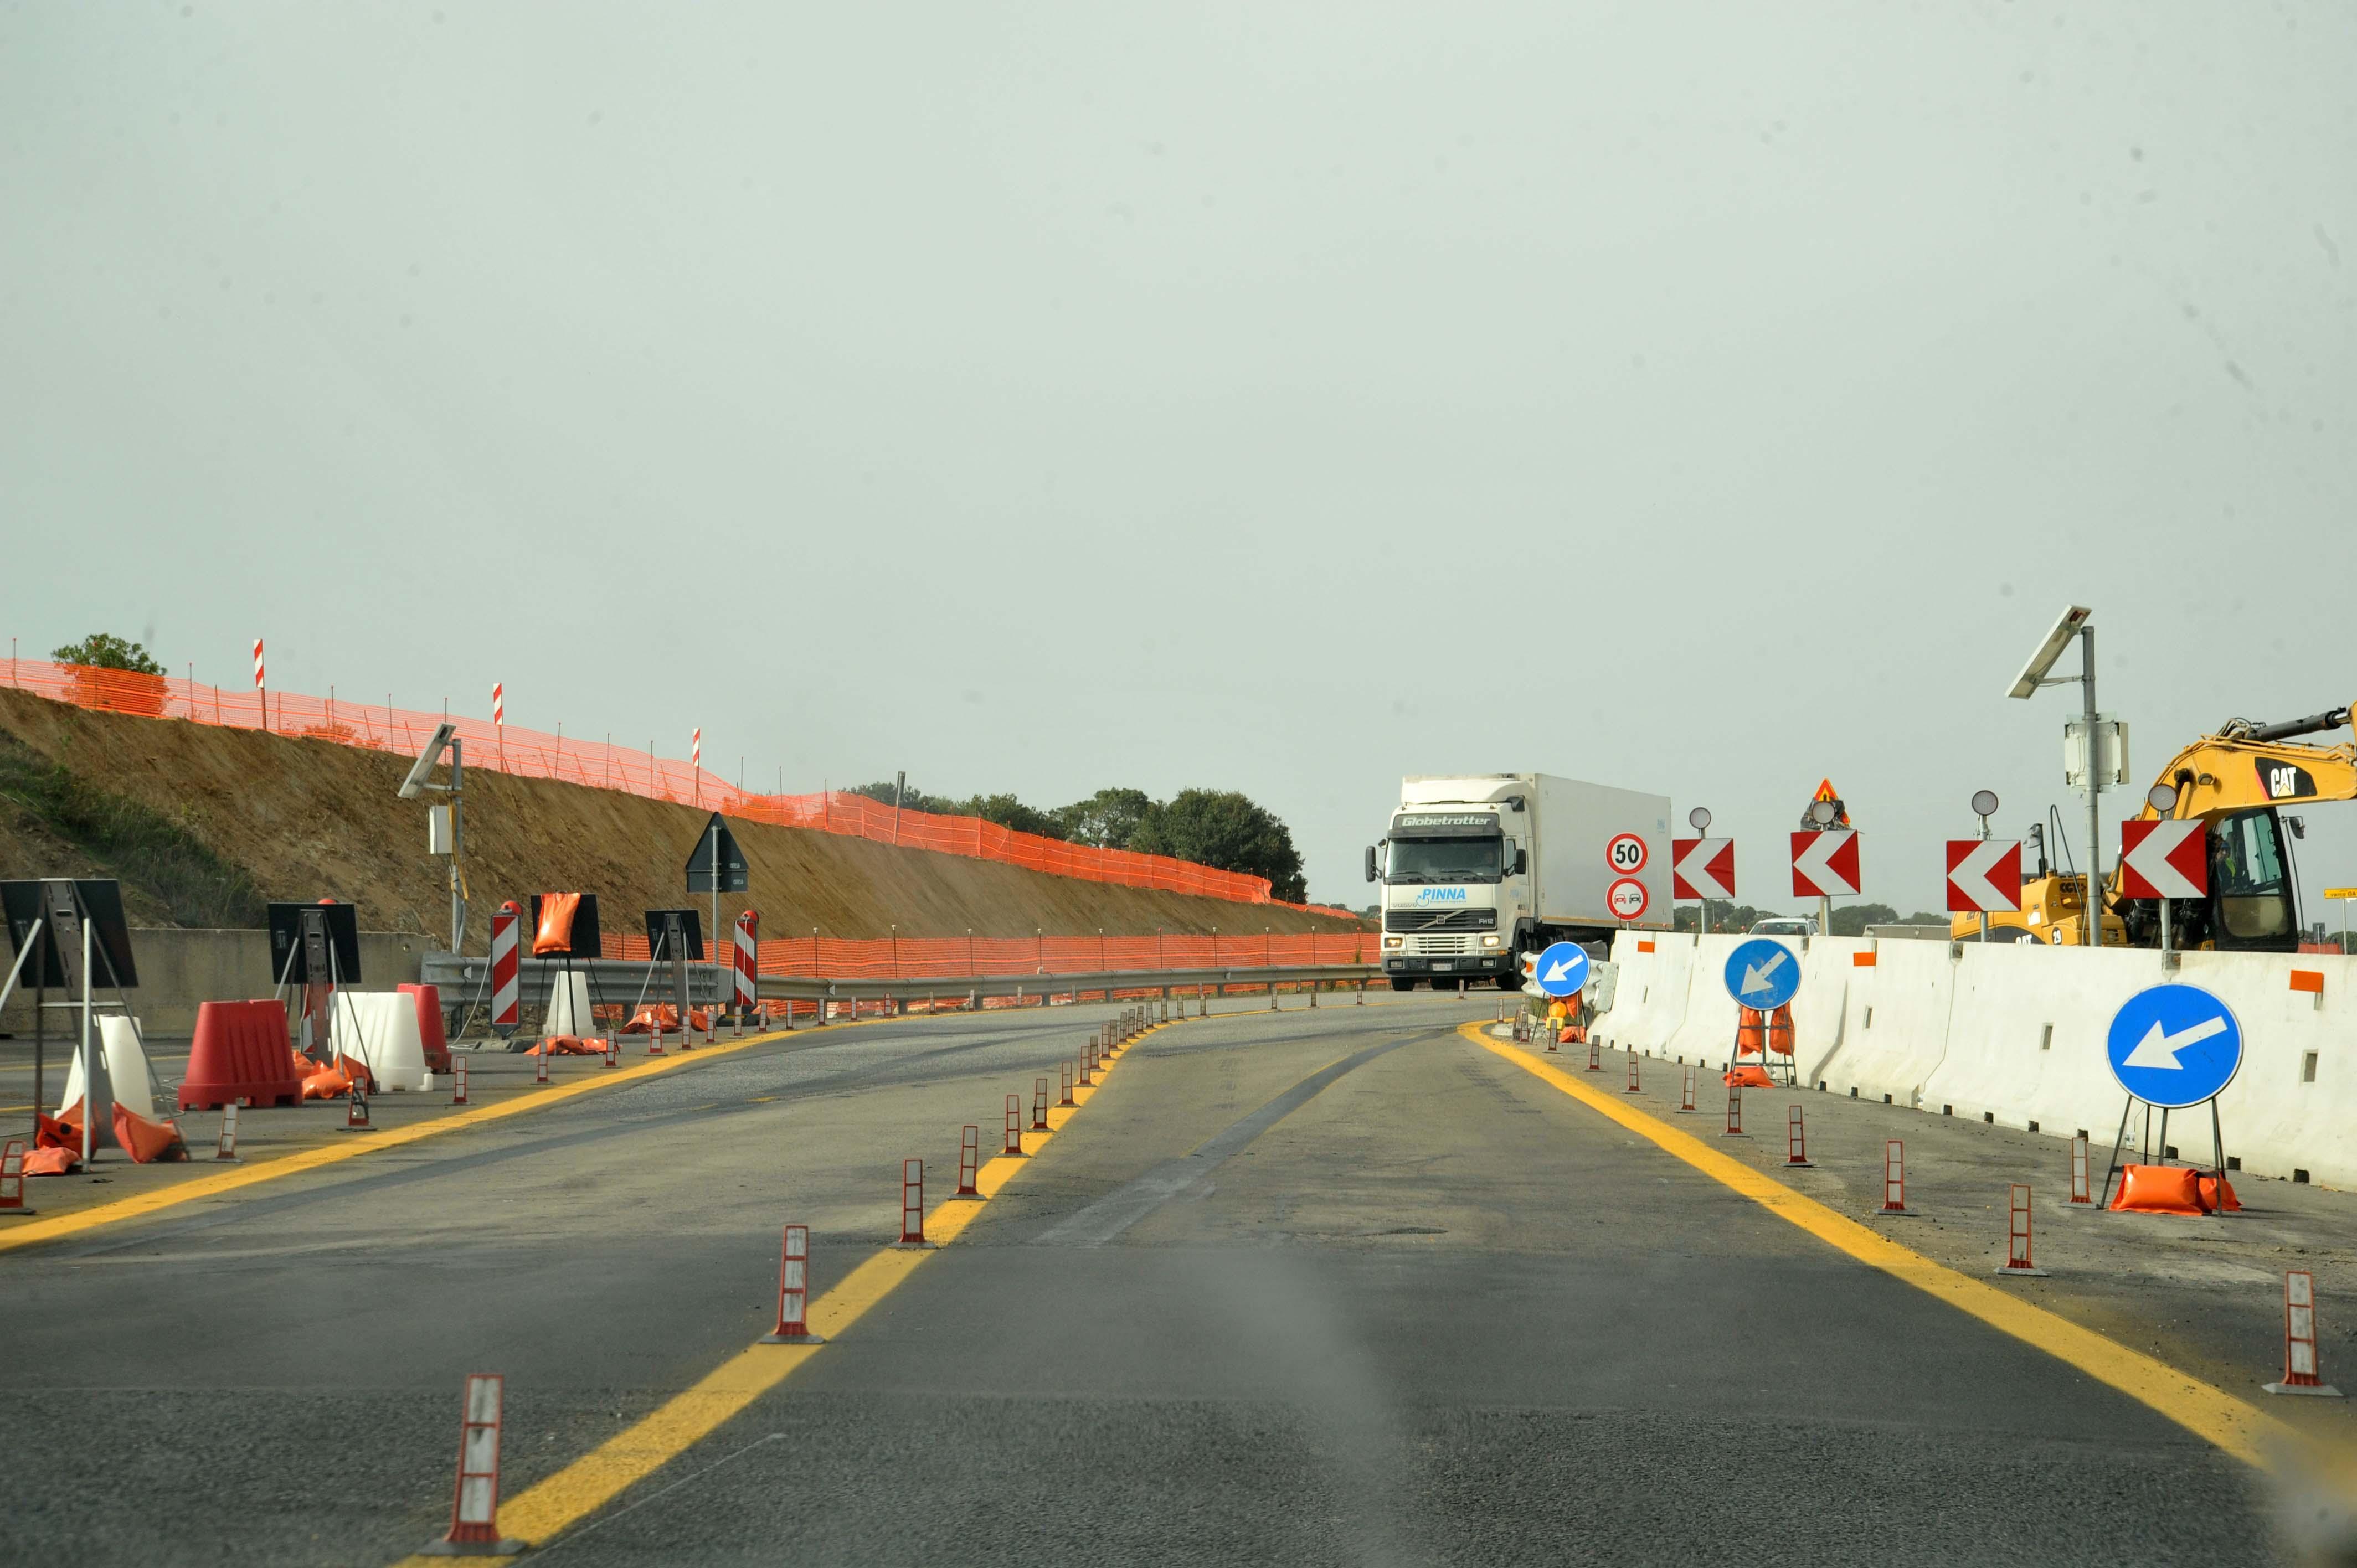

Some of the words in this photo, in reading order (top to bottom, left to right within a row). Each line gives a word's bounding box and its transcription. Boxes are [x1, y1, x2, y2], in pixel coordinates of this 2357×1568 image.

[2271, 767, 2296, 797] CAT
[1402, 816, 1491, 827] Globetrotter
[1615, 844, 1639, 864] 50
[1422, 888, 1466, 900] PINNA
